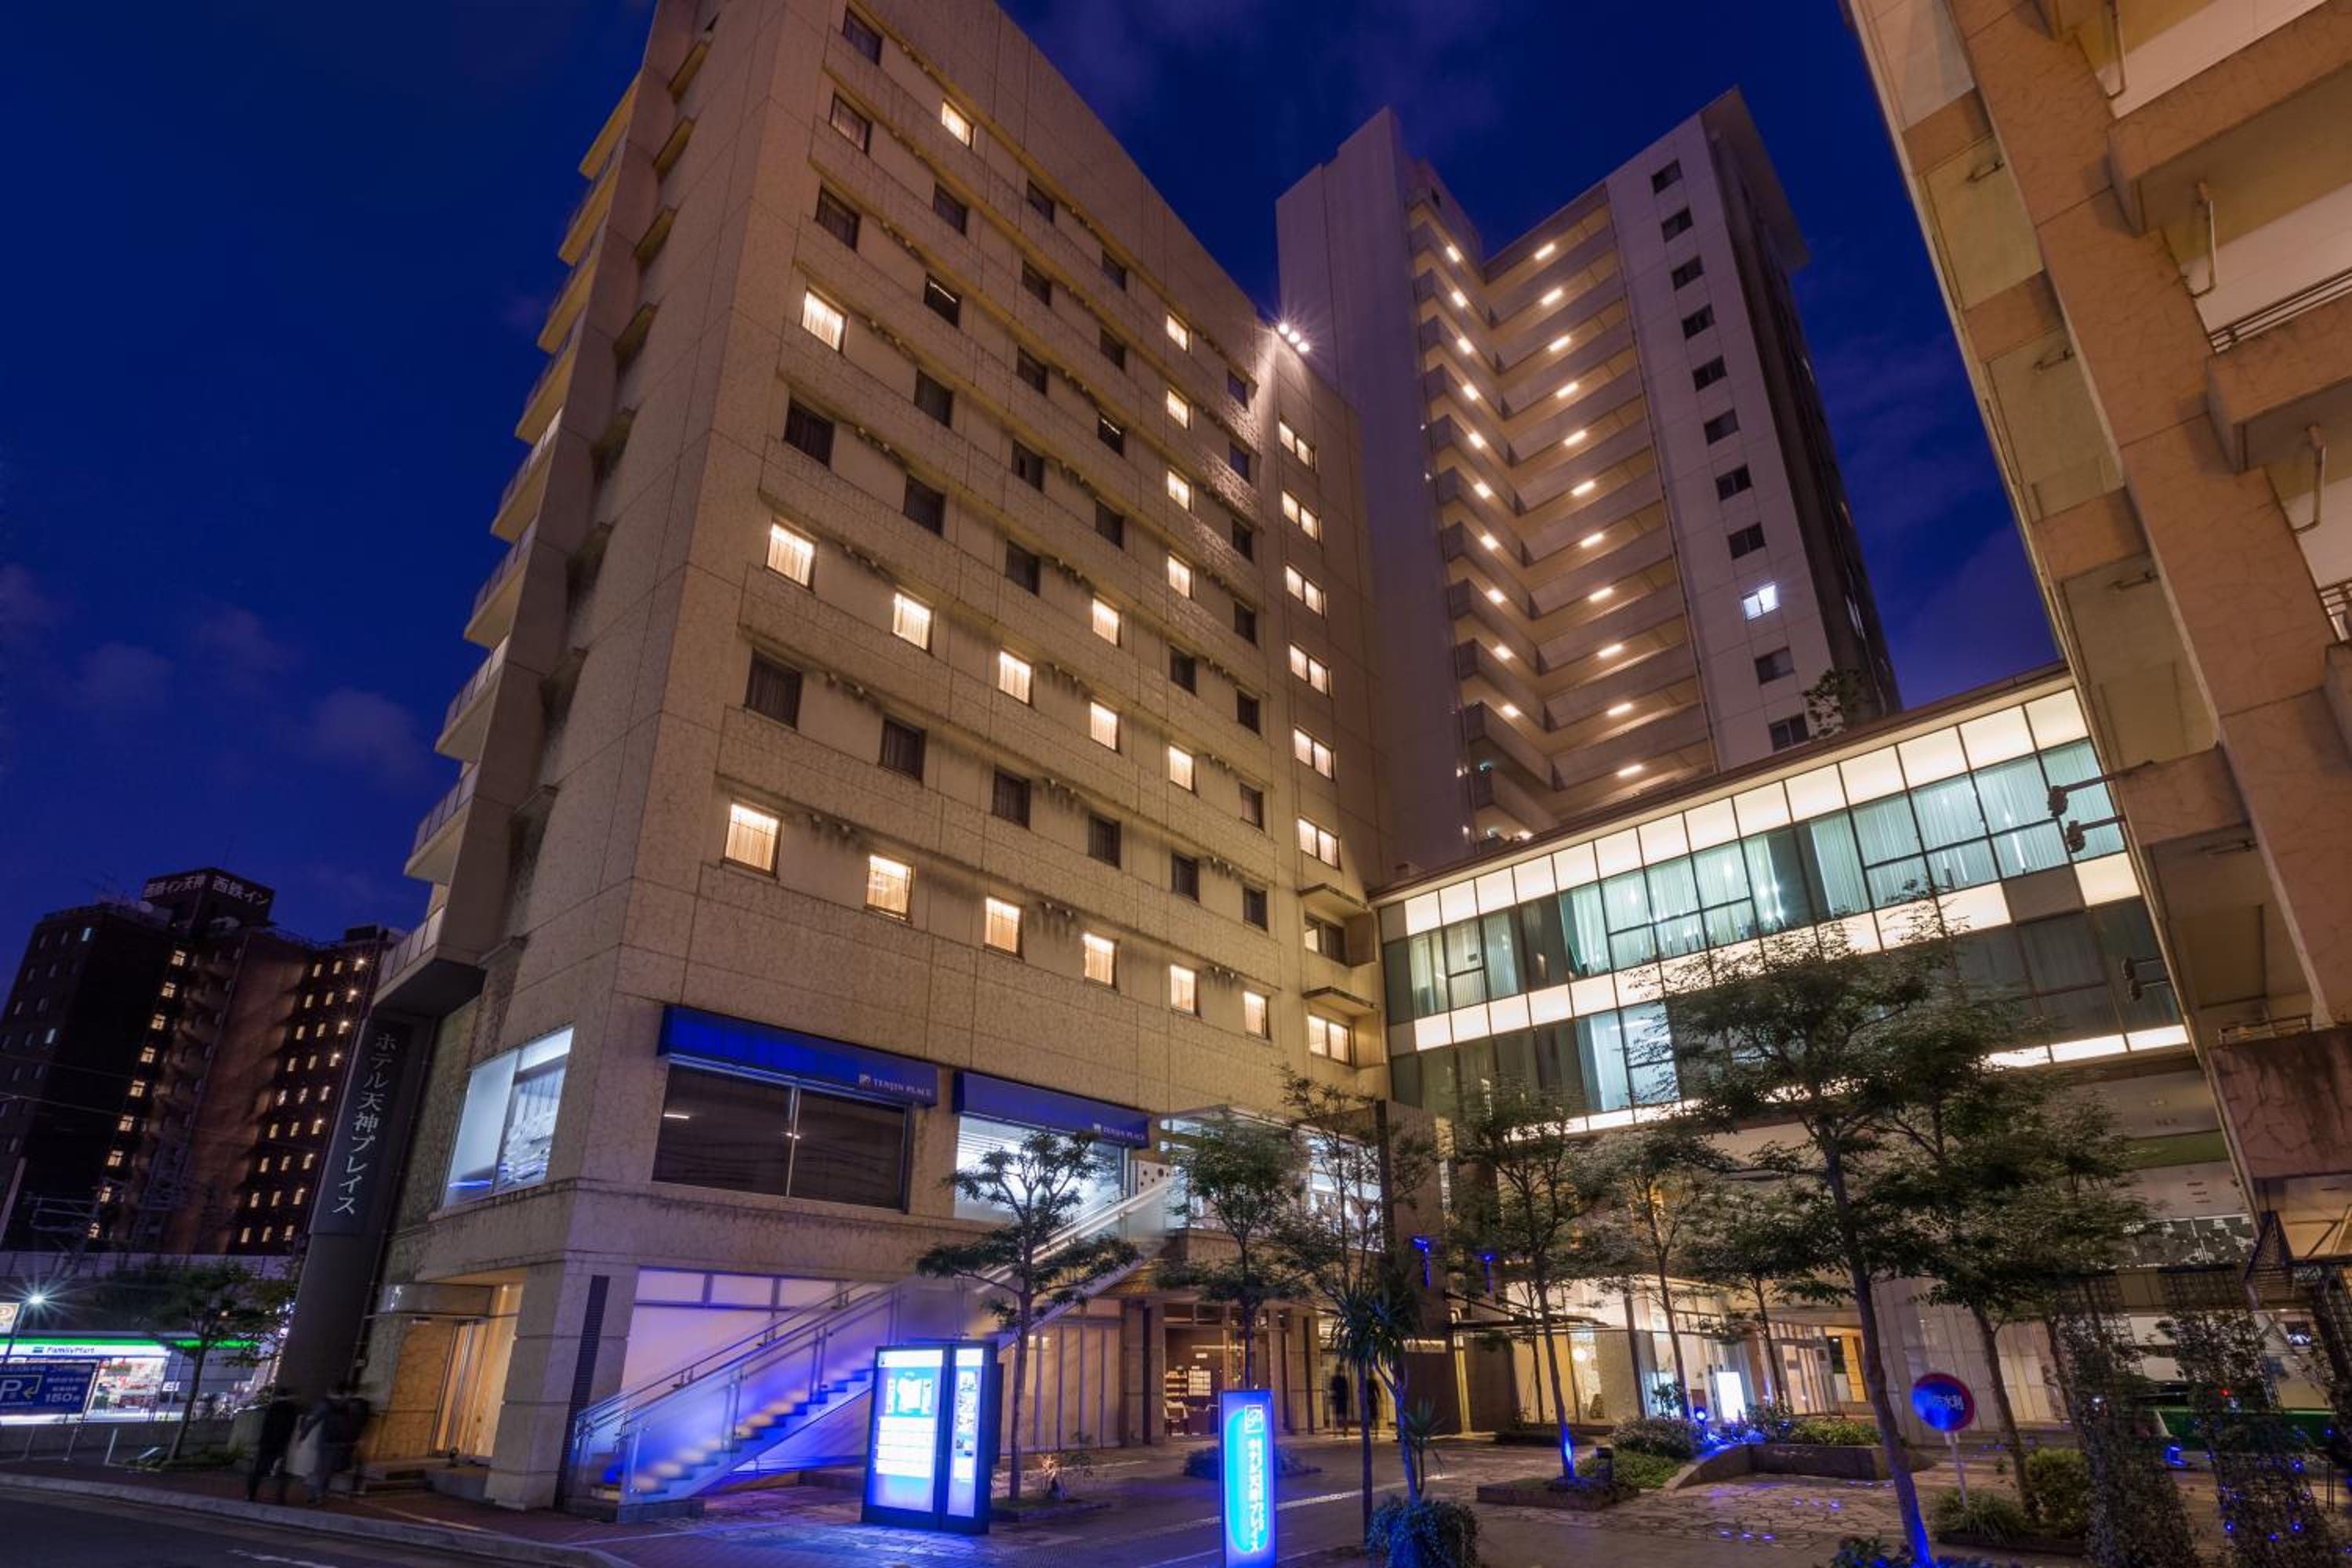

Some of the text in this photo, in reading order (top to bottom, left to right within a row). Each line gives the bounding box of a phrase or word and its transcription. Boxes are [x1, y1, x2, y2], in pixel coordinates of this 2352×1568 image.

[332, 1033, 397, 1214] ホテル天神プレイス
[47, 1346, 95, 1355] FamilyMart
